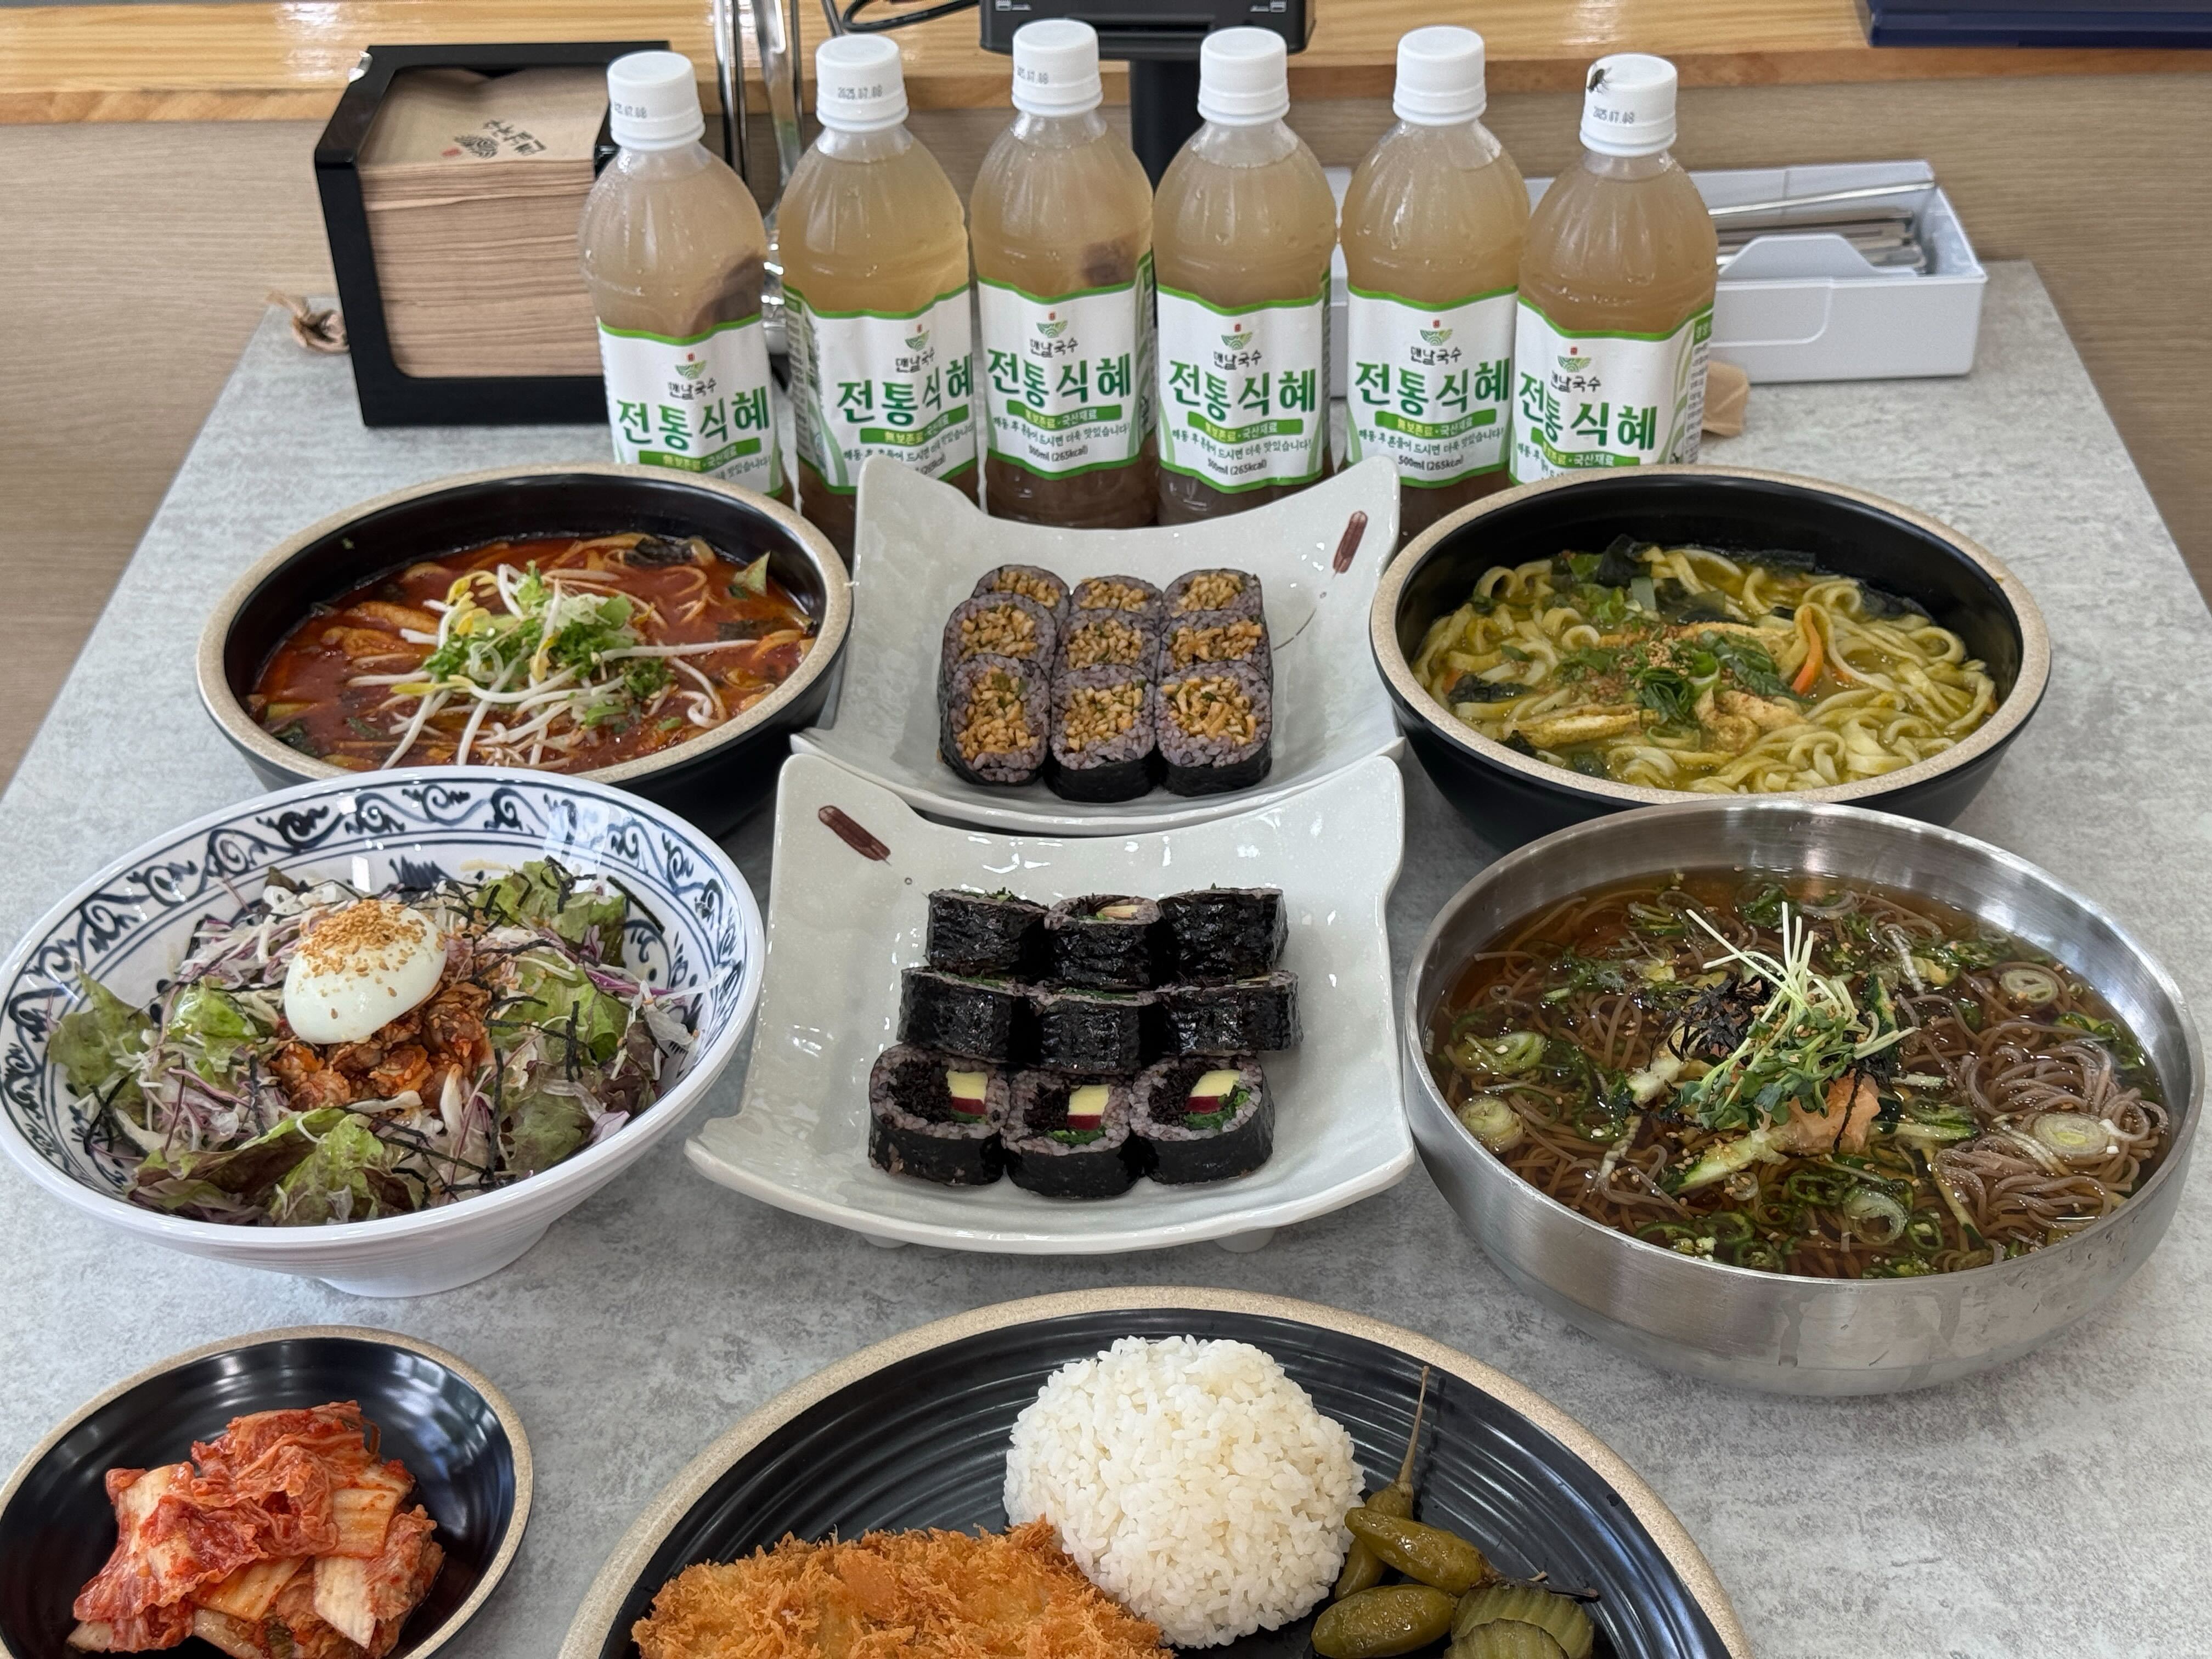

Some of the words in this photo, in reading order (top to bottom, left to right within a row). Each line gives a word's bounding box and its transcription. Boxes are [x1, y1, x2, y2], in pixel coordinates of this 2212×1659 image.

[987, 347, 1131, 409] 전통식혜
[1030, 337, 1079, 358] 맨날국수
[1213, 349, 1262, 371] 맨날국수
[1410, 346, 1463, 366] 맨날국수
[616, 385, 770, 451] 전통식혜
[836, 352, 974, 427] 전통식혜
[1167, 359, 1316, 422] 전통식혜
[1354, 357, 1510, 417] 전통식혜
[1518, 371, 1658, 451] 전통식혜
